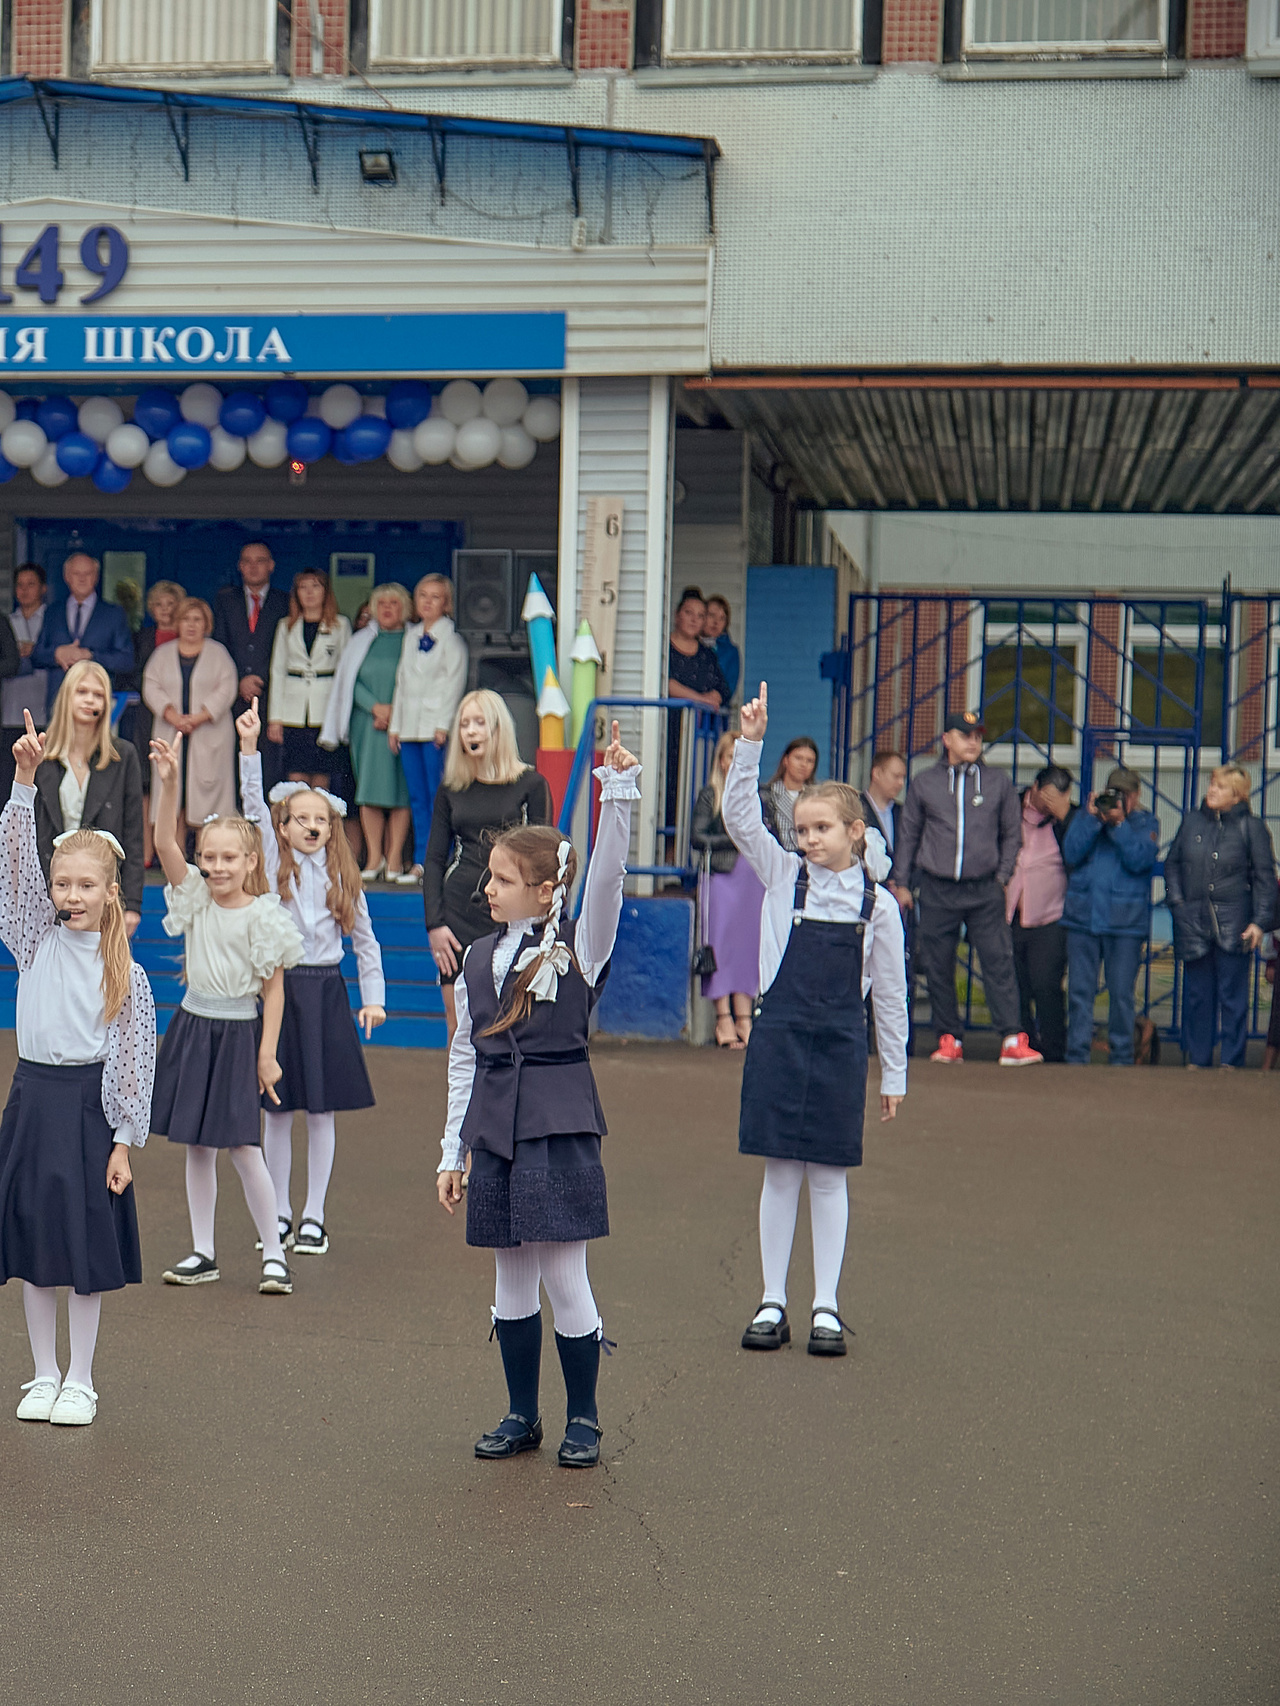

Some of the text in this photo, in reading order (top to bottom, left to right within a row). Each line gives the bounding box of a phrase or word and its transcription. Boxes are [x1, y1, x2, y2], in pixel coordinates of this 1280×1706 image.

[84, 326, 292, 363] ШКОЛА
[605, 513, 619, 537] 6
[600, 580, 616, 605] 5
